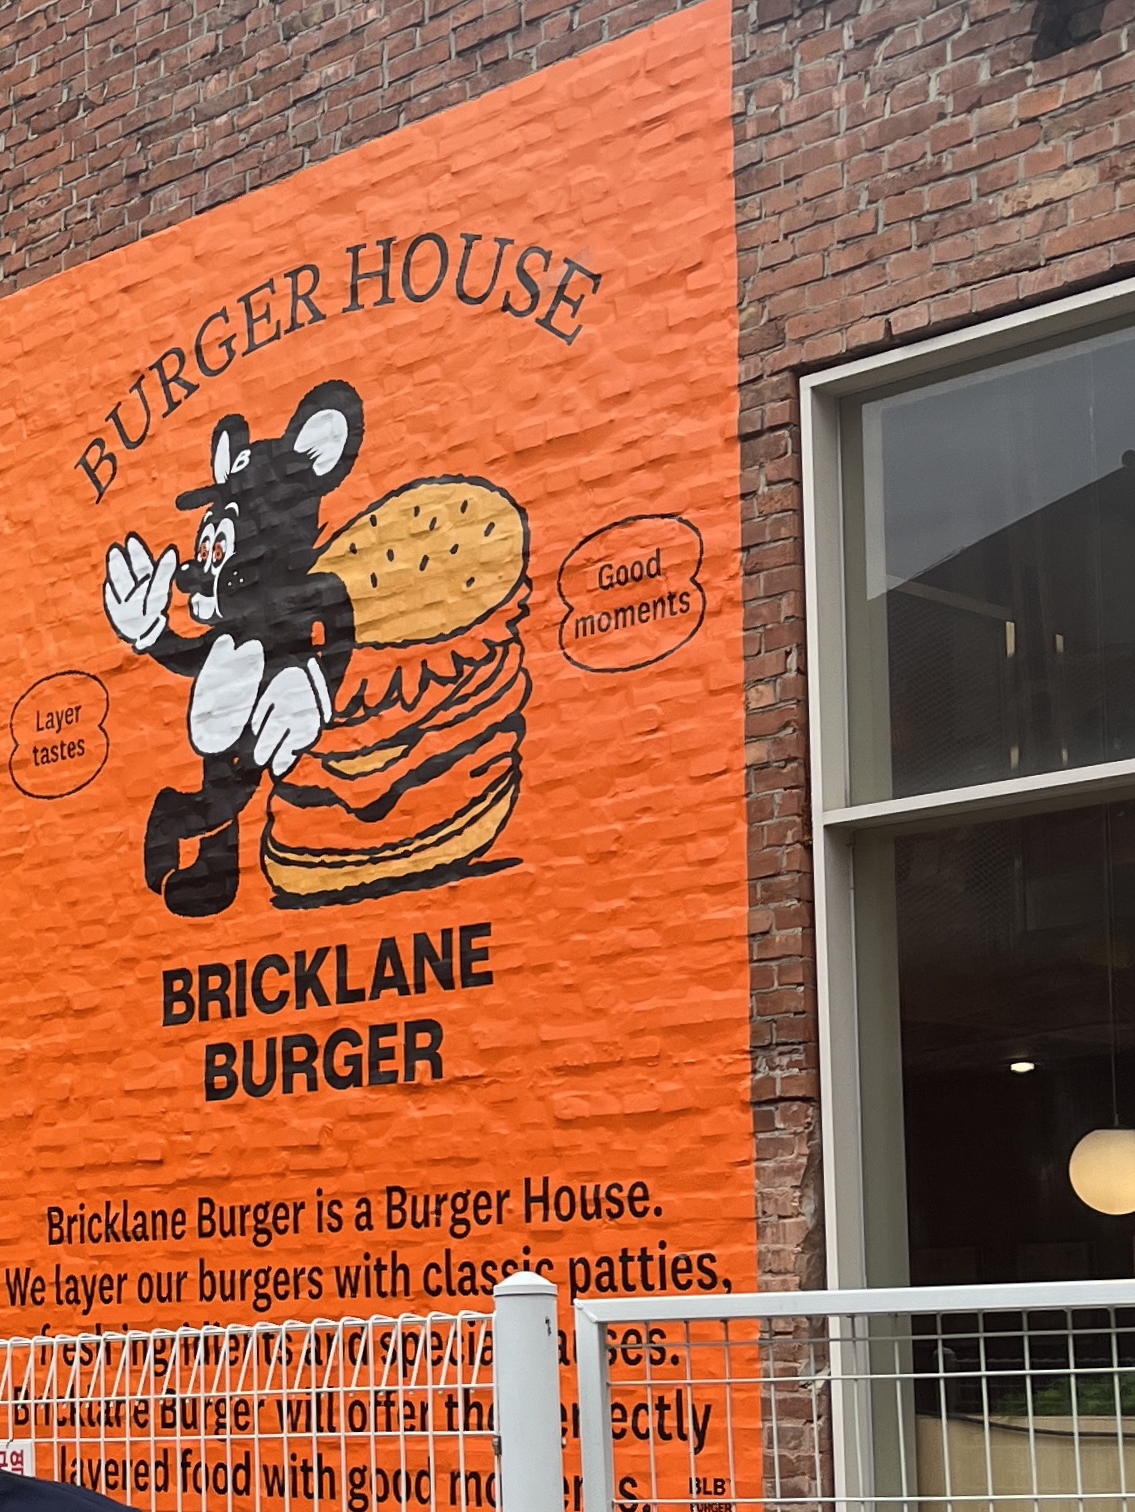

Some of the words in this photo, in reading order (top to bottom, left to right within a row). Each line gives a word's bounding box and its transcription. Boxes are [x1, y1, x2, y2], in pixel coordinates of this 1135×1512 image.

[74, 264, 326, 503] BURGER
[342, 233, 601, 345] HOUSE
[231, 449, 251, 473] B
[598, 547, 662, 590] Good
[575, 591, 690, 639] moments
[36, 705, 82, 734] Layer
[33, 739, 85, 766] tastes
[162, 922, 494, 1027] BRICKLANE
[205, 1019, 443, 1102] BURGER
[47, 1200, 186, 1245] Bricklane
[197, 1197, 305, 1247] Burger
[316, 1187, 343, 1233] is
[355, 1196, 374, 1232] a
[386, 1185, 510, 1239] Burger
[524, 1176, 663, 1223] House.
[5, 1267, 46, 1307] We
[55, 1264, 128, 1315] layer
[137, 1271, 188, 1304] our
[199, 1258, 323, 1312] burgers
[335, 1250, 411, 1300] with
[569, 1240, 732, 1305] patties,
[40, 1323, 112, 1366] fesh
[380, 1320, 495, 1378] specia
[14, 1384, 149, 1428] Bricklane
[161, 1388, 265, 1442] Burger
[276, 1387, 336, 1433] will
[348, 1390, 429, 1432] offer
[445, 1388, 494, 1431] th
[61, 1446, 169, 1492] layered
[181, 1448, 250, 1496] food
[263, 1453, 336, 1500] with
[348, 1456, 432, 1512] good
